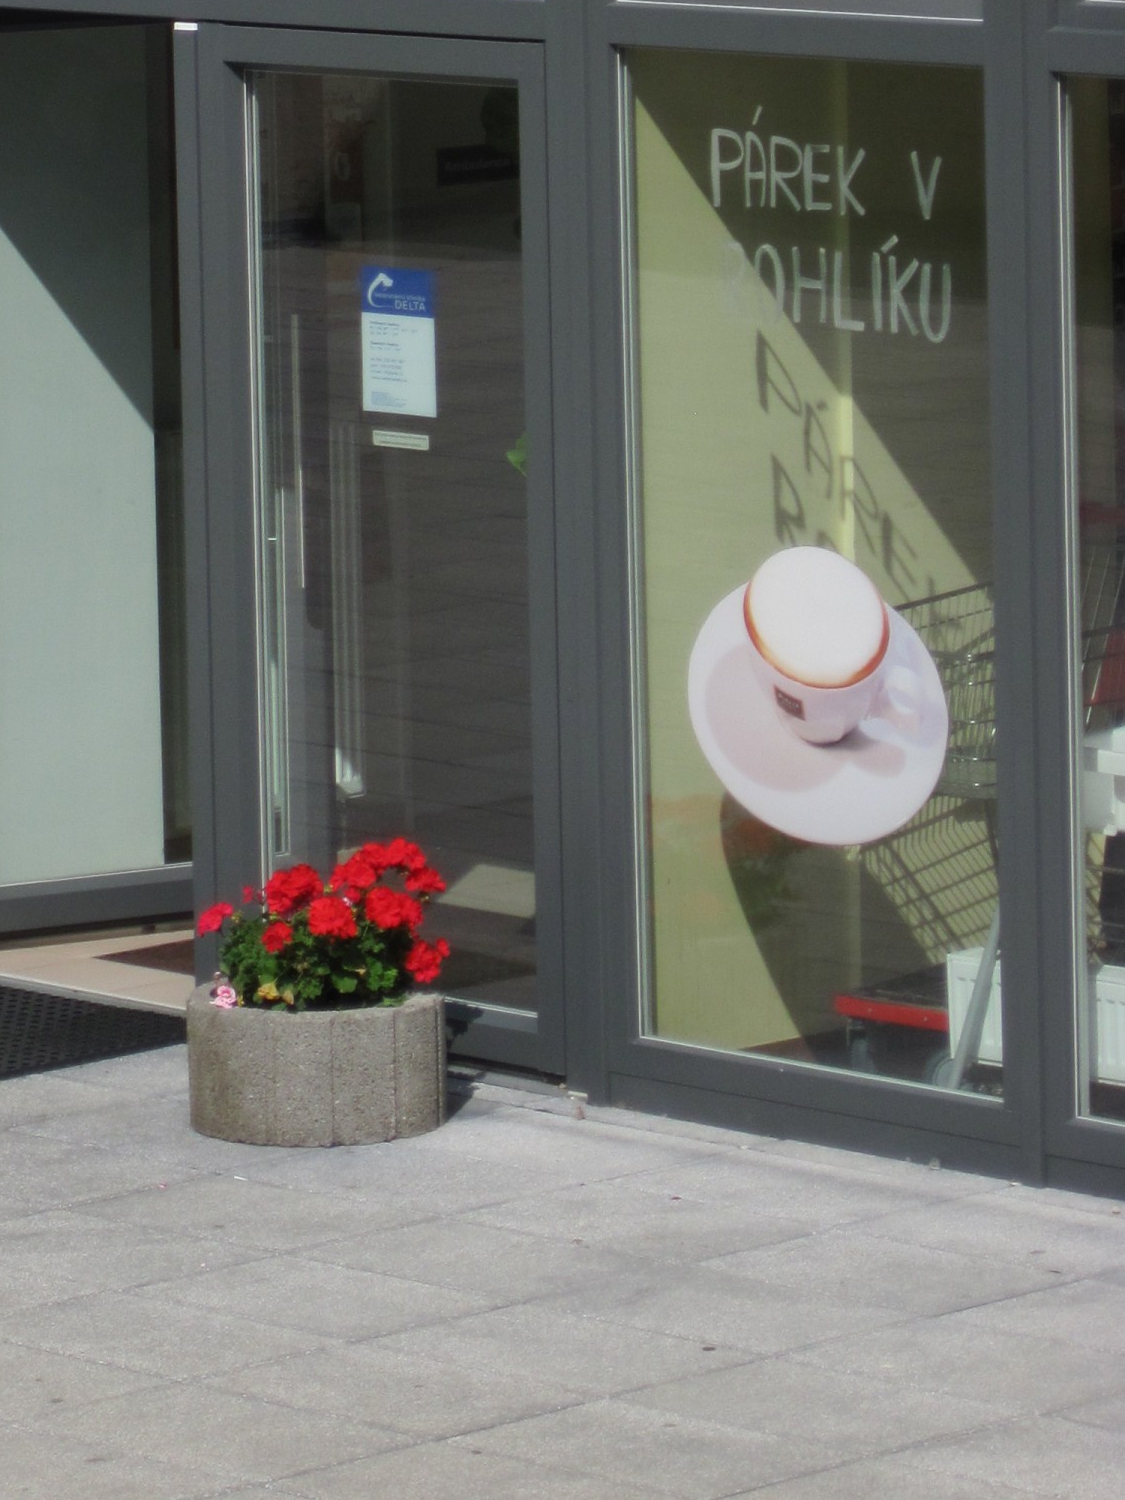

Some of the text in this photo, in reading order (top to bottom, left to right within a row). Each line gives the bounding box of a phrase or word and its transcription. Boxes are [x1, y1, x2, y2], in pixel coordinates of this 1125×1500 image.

[709, 104, 943, 221] PÁREK V
[394, 299, 426, 312] DELTA
